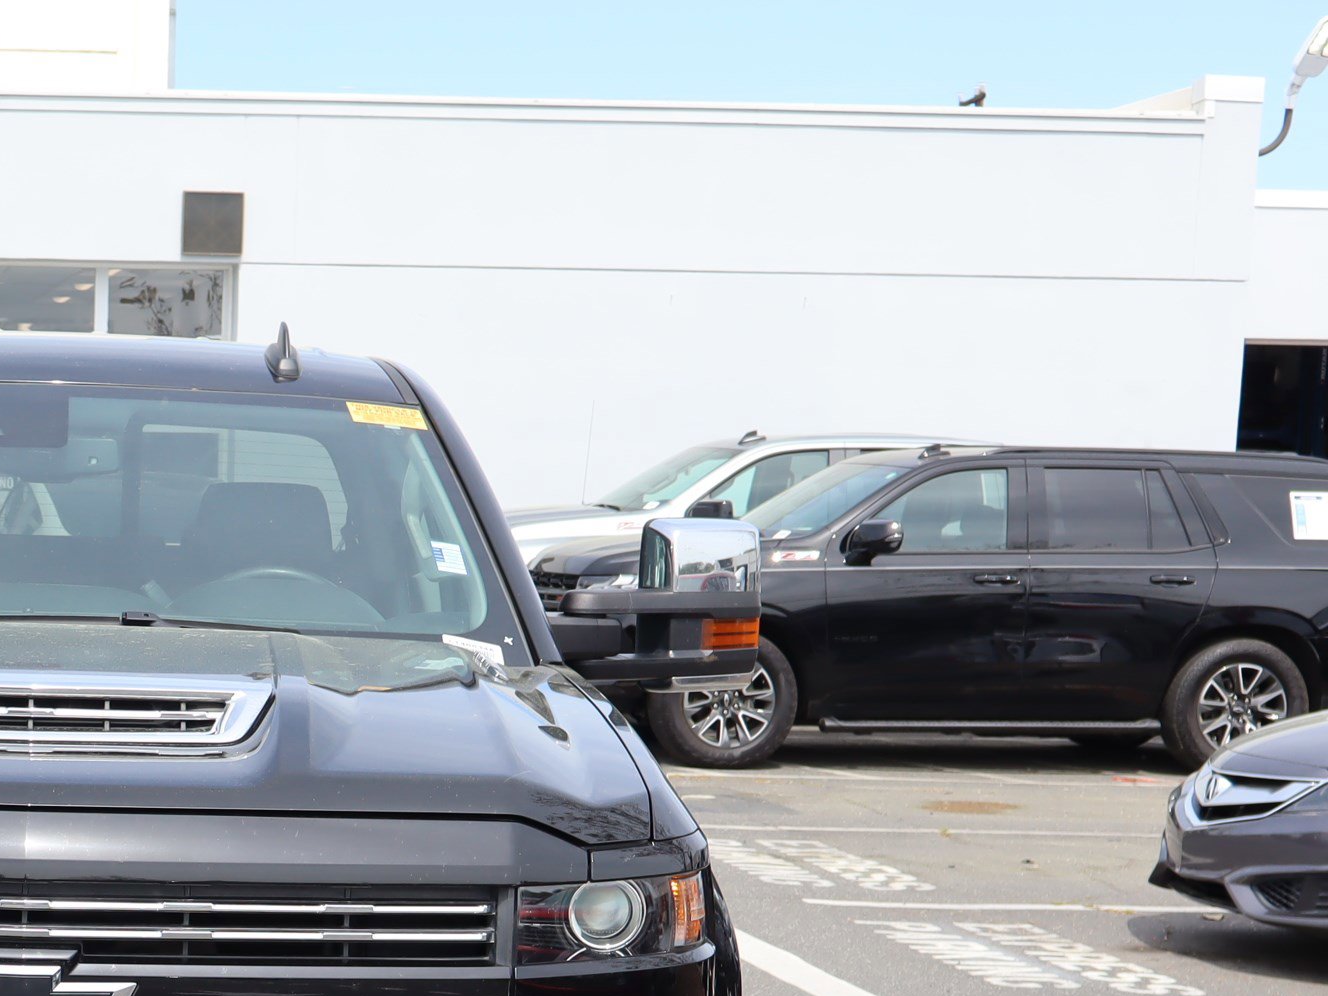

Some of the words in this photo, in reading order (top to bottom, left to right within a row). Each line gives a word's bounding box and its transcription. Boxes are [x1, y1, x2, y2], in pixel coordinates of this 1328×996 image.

[755, 839, 937, 891] EXPRESS
[854, 919, 1082, 989] PARKING
[953, 921, 1206, 996] EXPRESS
